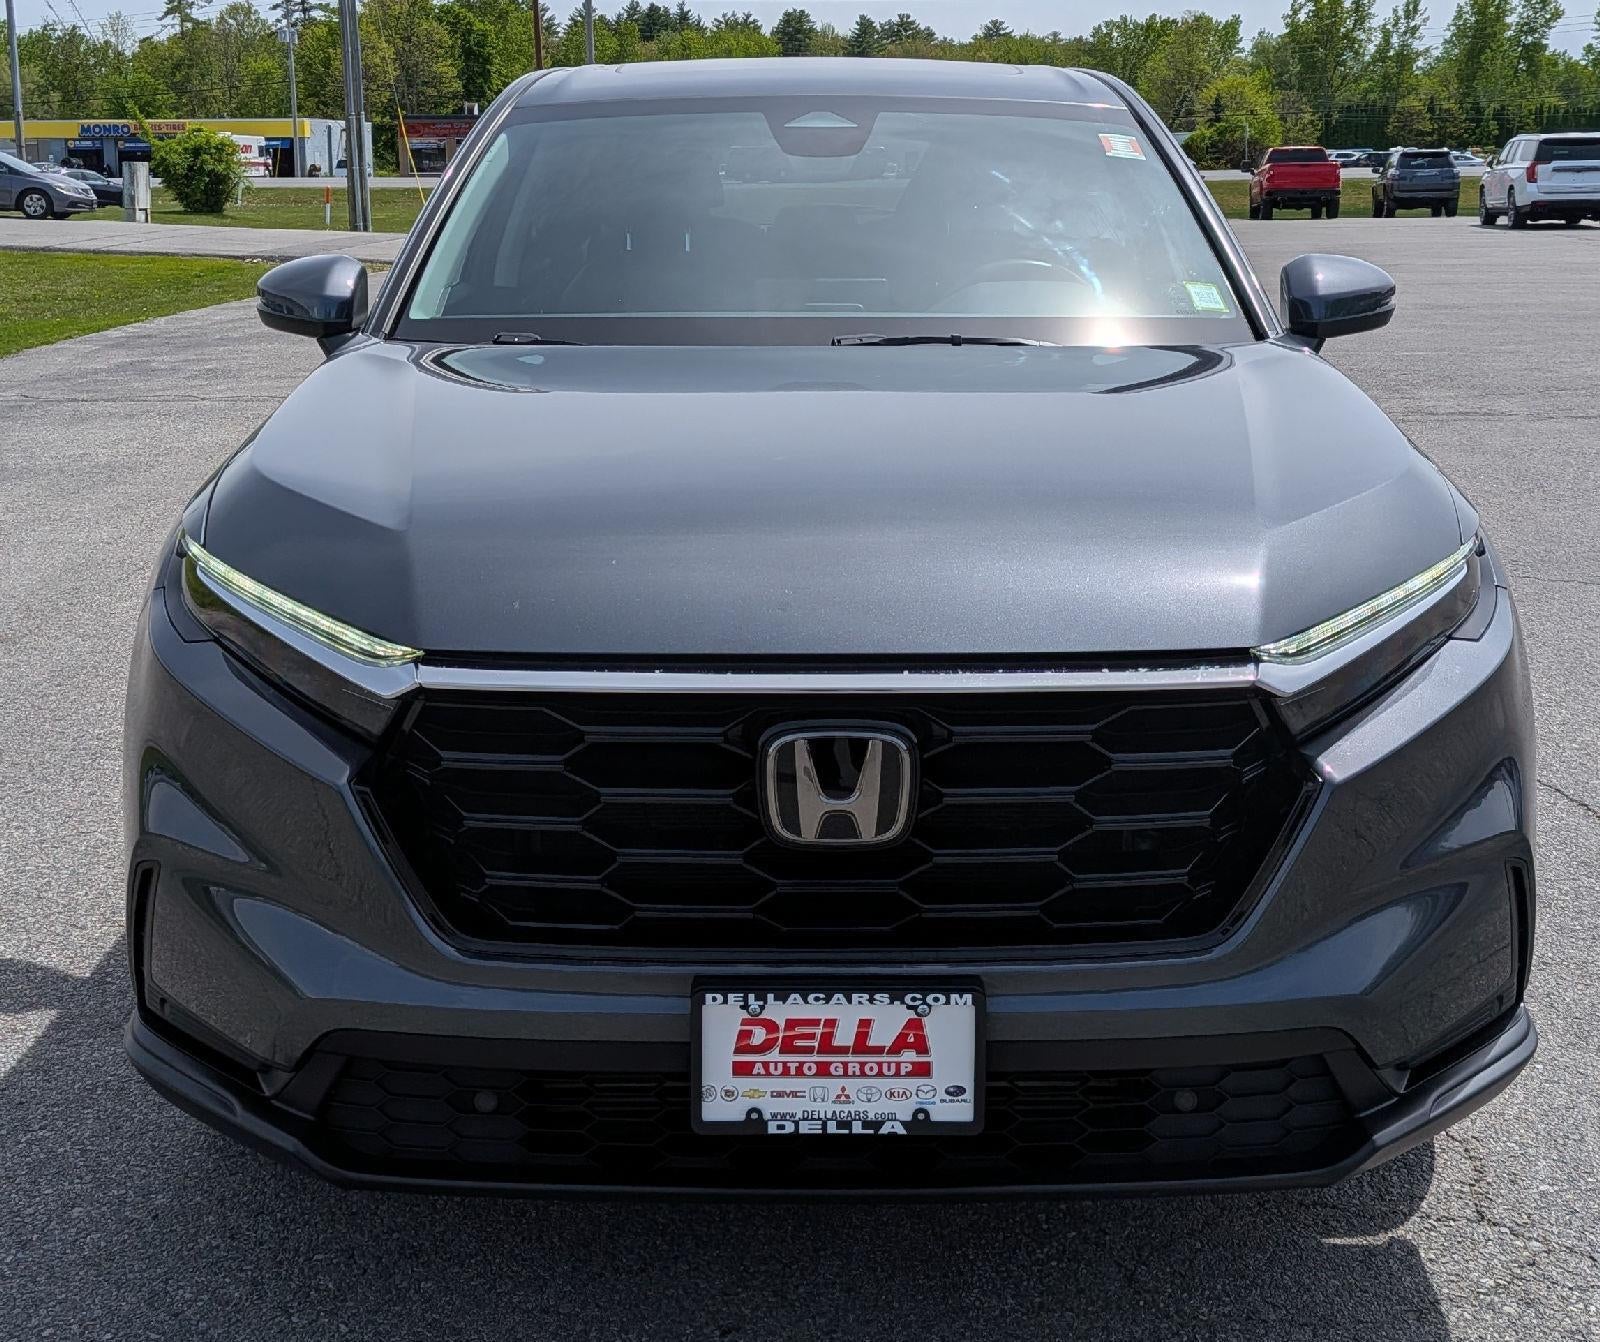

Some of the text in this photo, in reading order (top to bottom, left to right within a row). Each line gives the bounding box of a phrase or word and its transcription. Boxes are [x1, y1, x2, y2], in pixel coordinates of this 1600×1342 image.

[80, 123, 132, 137] MONRO
[704, 993, 974, 1006] DELLACARS.COM
[732, 1016, 932, 1058] DELLA
[752, 1062, 914, 1076] AUTO GROUP
[769, 1090, 807, 1099] GMC
[769, 1109, 897, 1121] www.DELLACARS.com
[767, 1120, 908, 1135] DELLA
